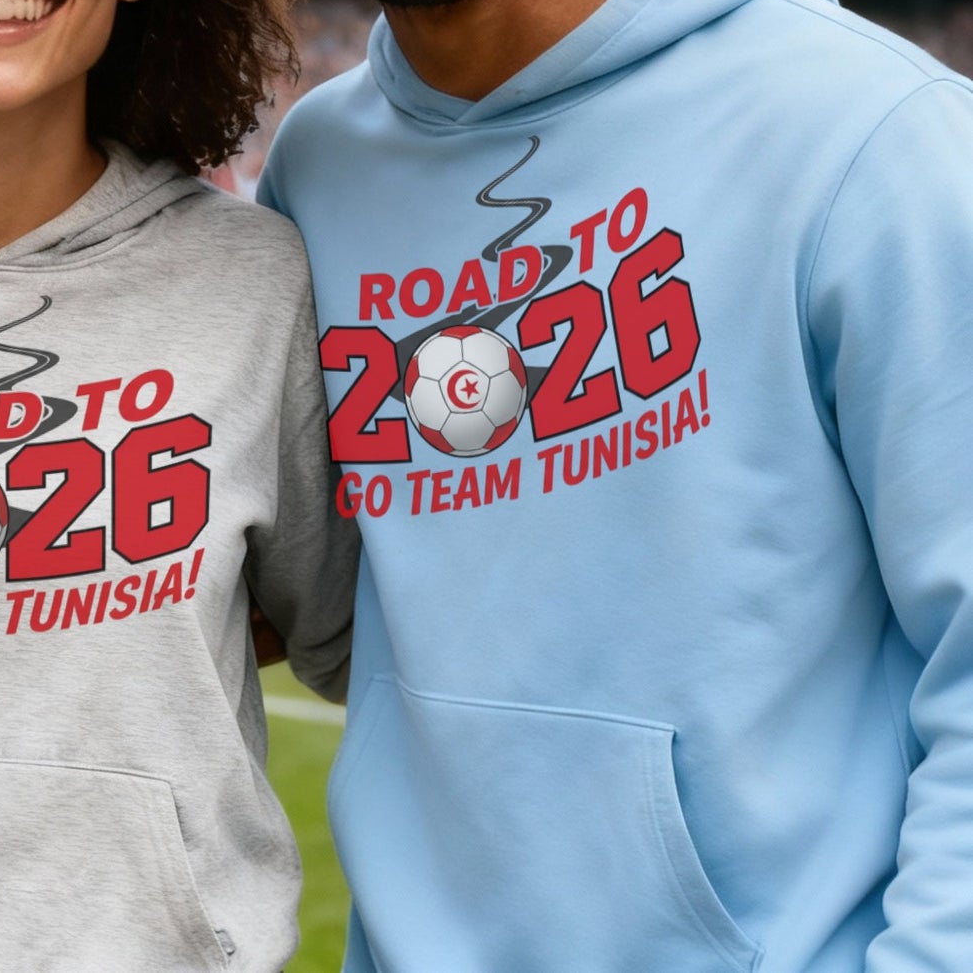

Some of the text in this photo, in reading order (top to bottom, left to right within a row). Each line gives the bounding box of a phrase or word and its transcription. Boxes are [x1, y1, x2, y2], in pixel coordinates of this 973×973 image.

[358, 187, 648, 321] ROAD TO
[75, 369, 174, 431] TO
[335, 368, 711, 519] GO TEAM TUNISIA!
[6, 548, 205, 635] TUNISIA!
